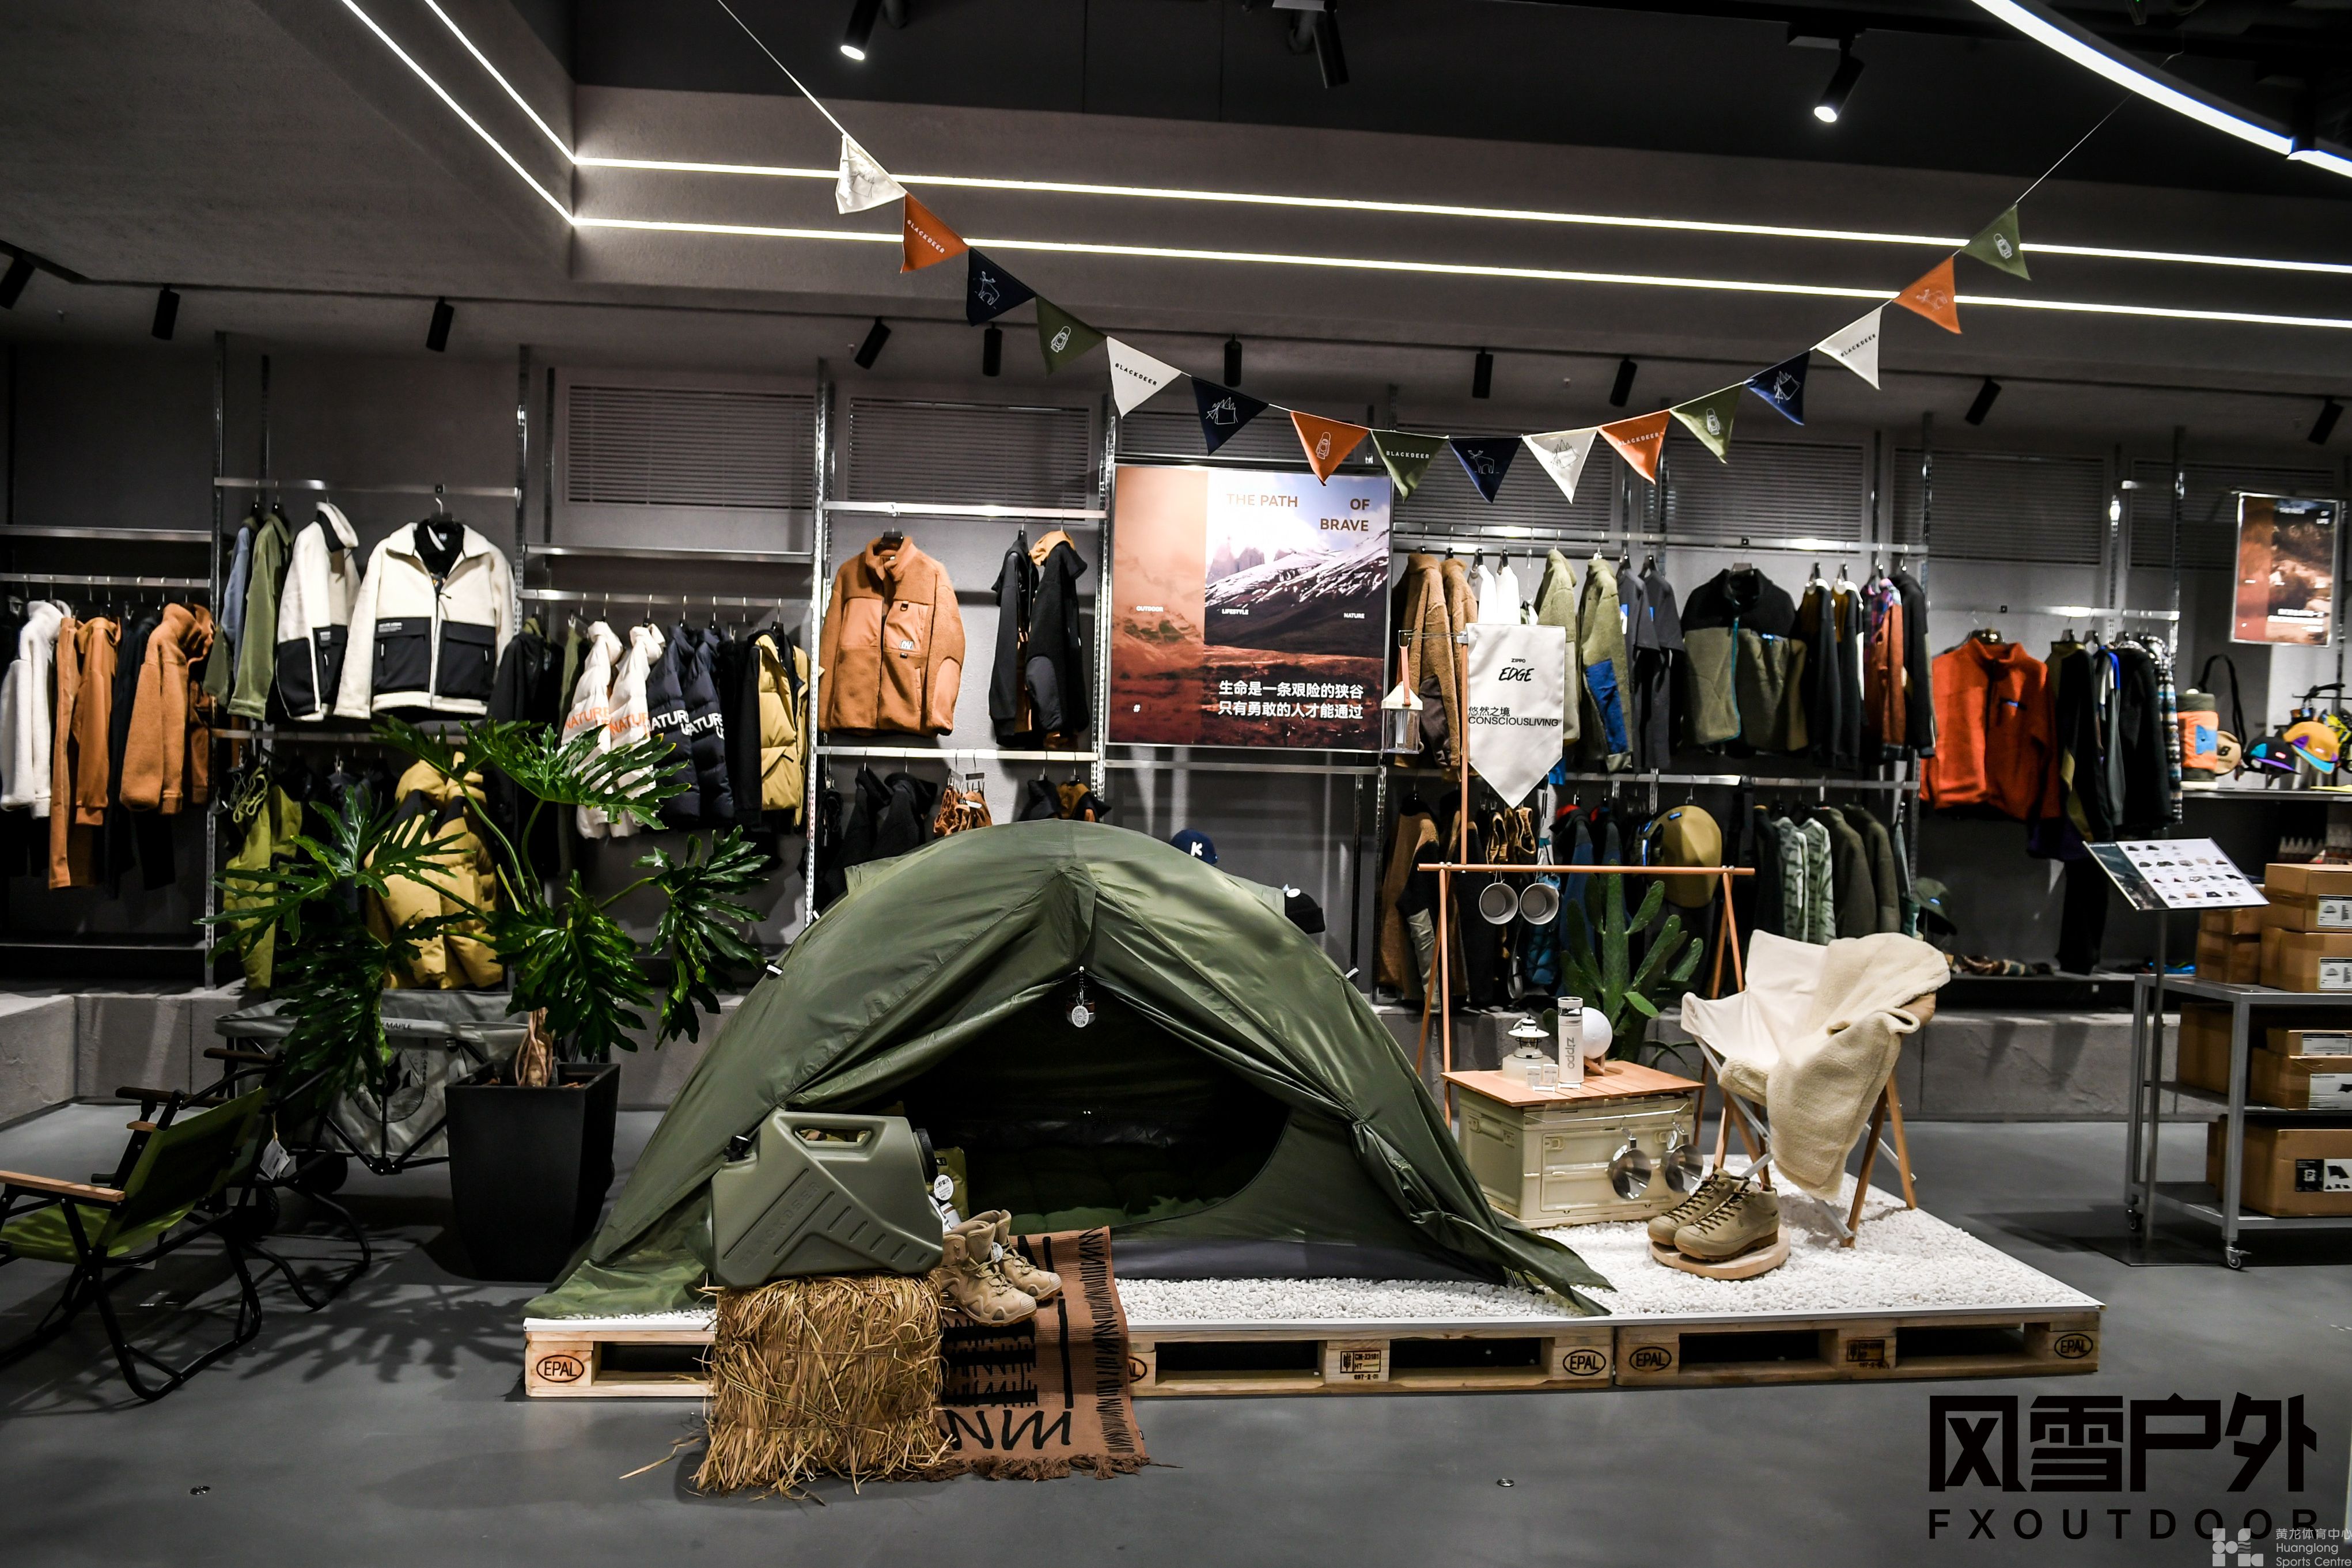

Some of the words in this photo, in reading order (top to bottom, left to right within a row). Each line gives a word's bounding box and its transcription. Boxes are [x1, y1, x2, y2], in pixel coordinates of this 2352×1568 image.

[907, 219, 945, 253] BLACKDEER
[1840, 334, 1876, 357] BLACKDEER
[1115, 363, 1157, 386] BLACKDEER
[1618, 432, 1659, 446] BLACKDEER
[1386, 450, 1430, 460] BLACKDEER
[1226, 494, 1255, 505] THE
[1260, 495, 1298, 507] PATH
[1350, 498, 1370, 510] OF
[1320, 518, 1369, 531] BRAVE
[1498, 667, 1535, 681] EDGE
[1219, 680, 1364, 699] 生命是一条艰险的狭谷
[1218, 700, 1363, 719] 只有勇敢的人才能通过
[1468, 706, 1510, 717] 悠然之境
[1468, 717, 1558, 726] CONSCIOUSLIVING
[1191, 842, 1202, 856] K
[1565, 1037, 1576, 1069] zippo
[2061, 1338, 2089, 1354] EPAL
[1570, 1354, 1601, 1370] EPAL
[1635, 1351, 1667, 1368] EPAL
[544, 1361, 577, 1377] EPAL
